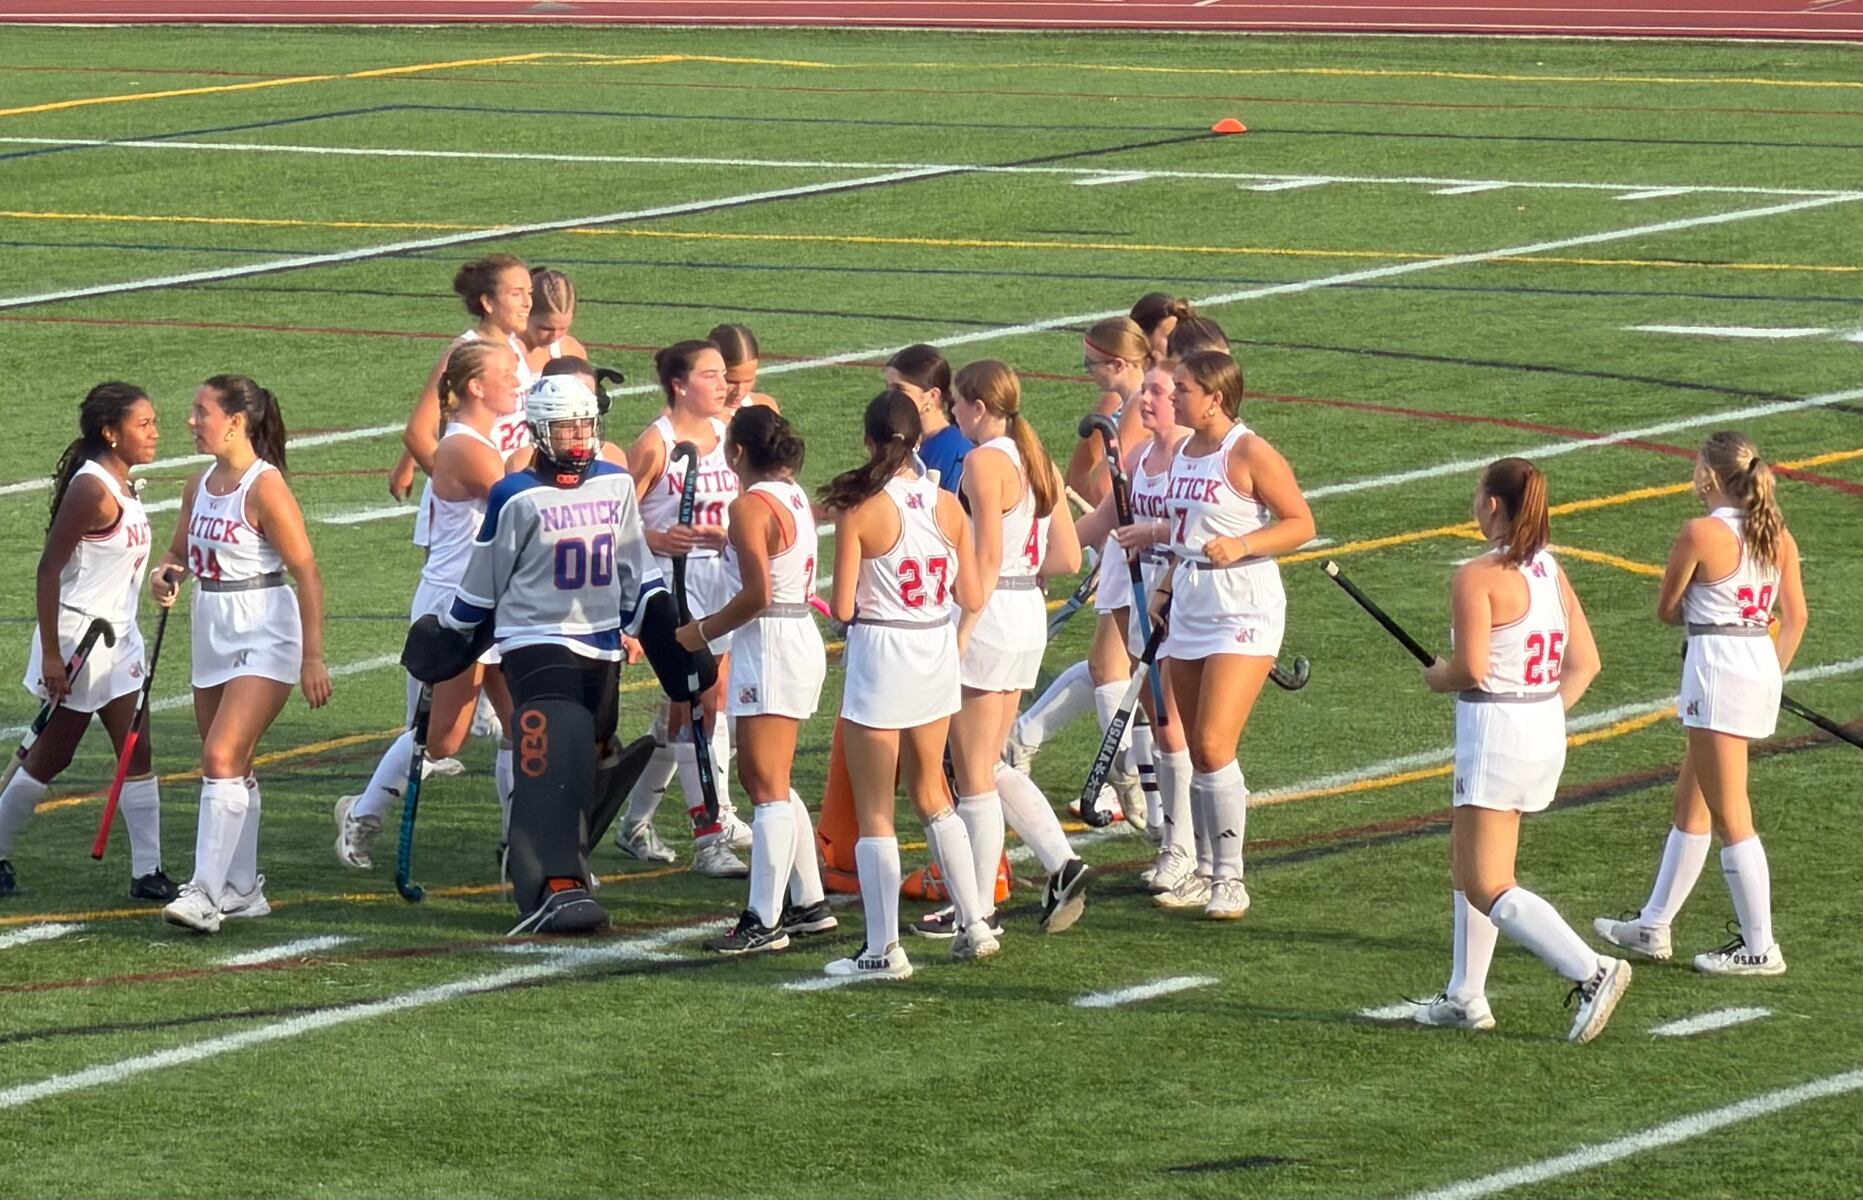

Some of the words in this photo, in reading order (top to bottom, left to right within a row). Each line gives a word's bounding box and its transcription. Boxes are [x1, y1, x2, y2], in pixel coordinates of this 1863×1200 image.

[667, 470, 739, 495] NTIC
[1166, 476, 1222, 504] ATICK
[541, 501, 621, 532] NATICK
[1130, 493, 1169, 519] ATIC
[188, 513, 241, 544] ATICK
[1175, 507, 1188, 544] 7
[554, 533, 613, 590] 00
[896, 556, 948, 610] 27
[1524, 631, 1564, 685] 25
[1098, 718, 1125, 762] OSAKA
[1733, 954, 1768, 965] OSAKA
